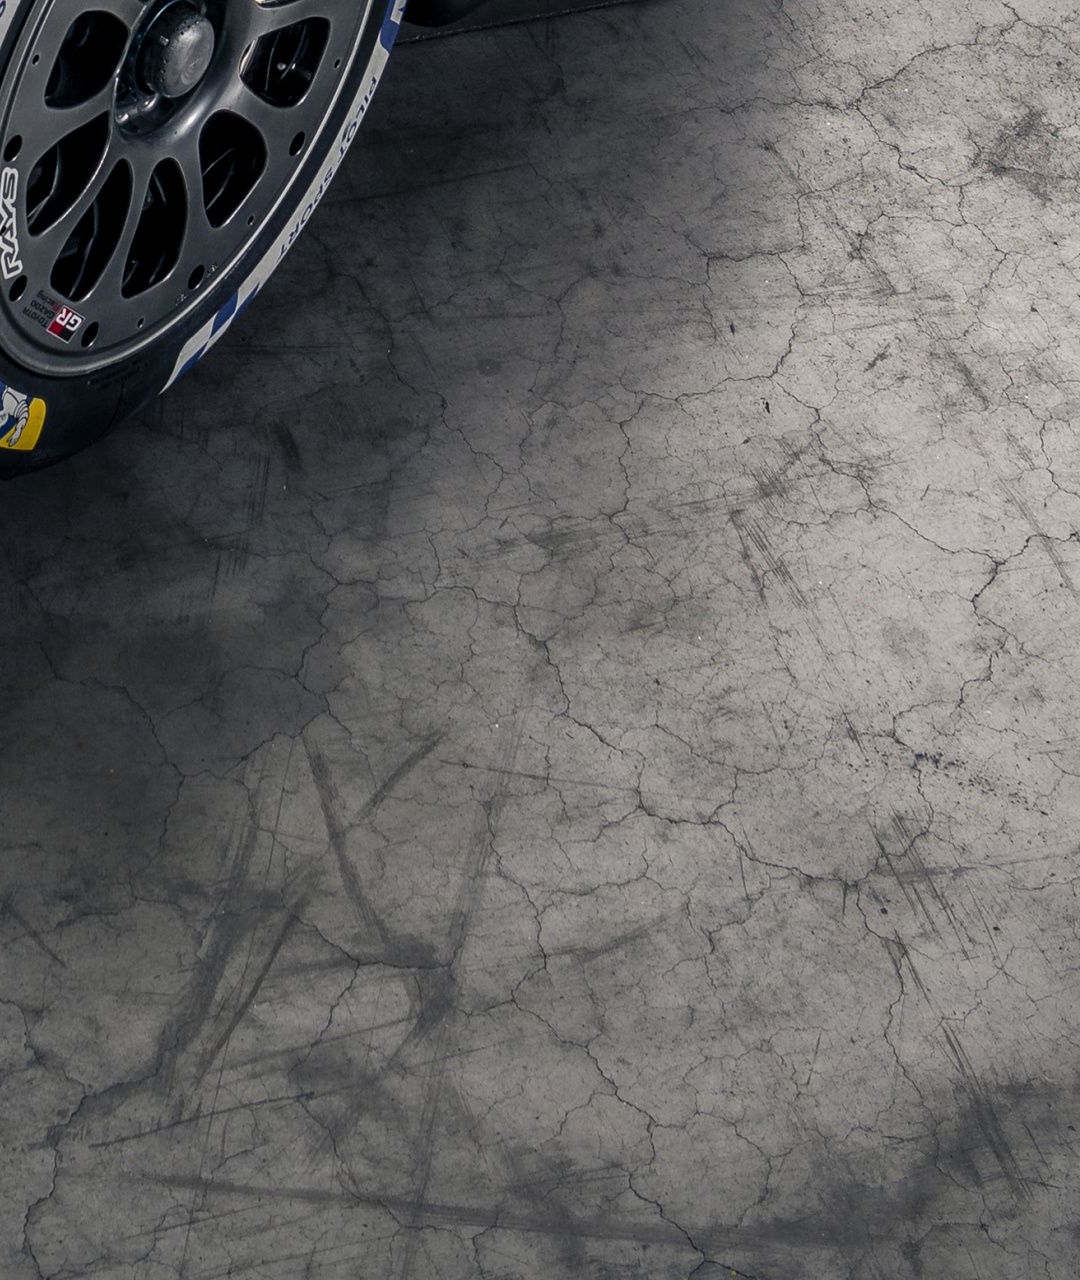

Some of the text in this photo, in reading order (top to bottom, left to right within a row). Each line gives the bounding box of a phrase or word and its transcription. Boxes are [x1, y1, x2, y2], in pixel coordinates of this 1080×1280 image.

[0, 167, 23, 279] RAYS
[276, 76, 377, 263] PILOT SPORT
[56, 308, 82, 331] GR
